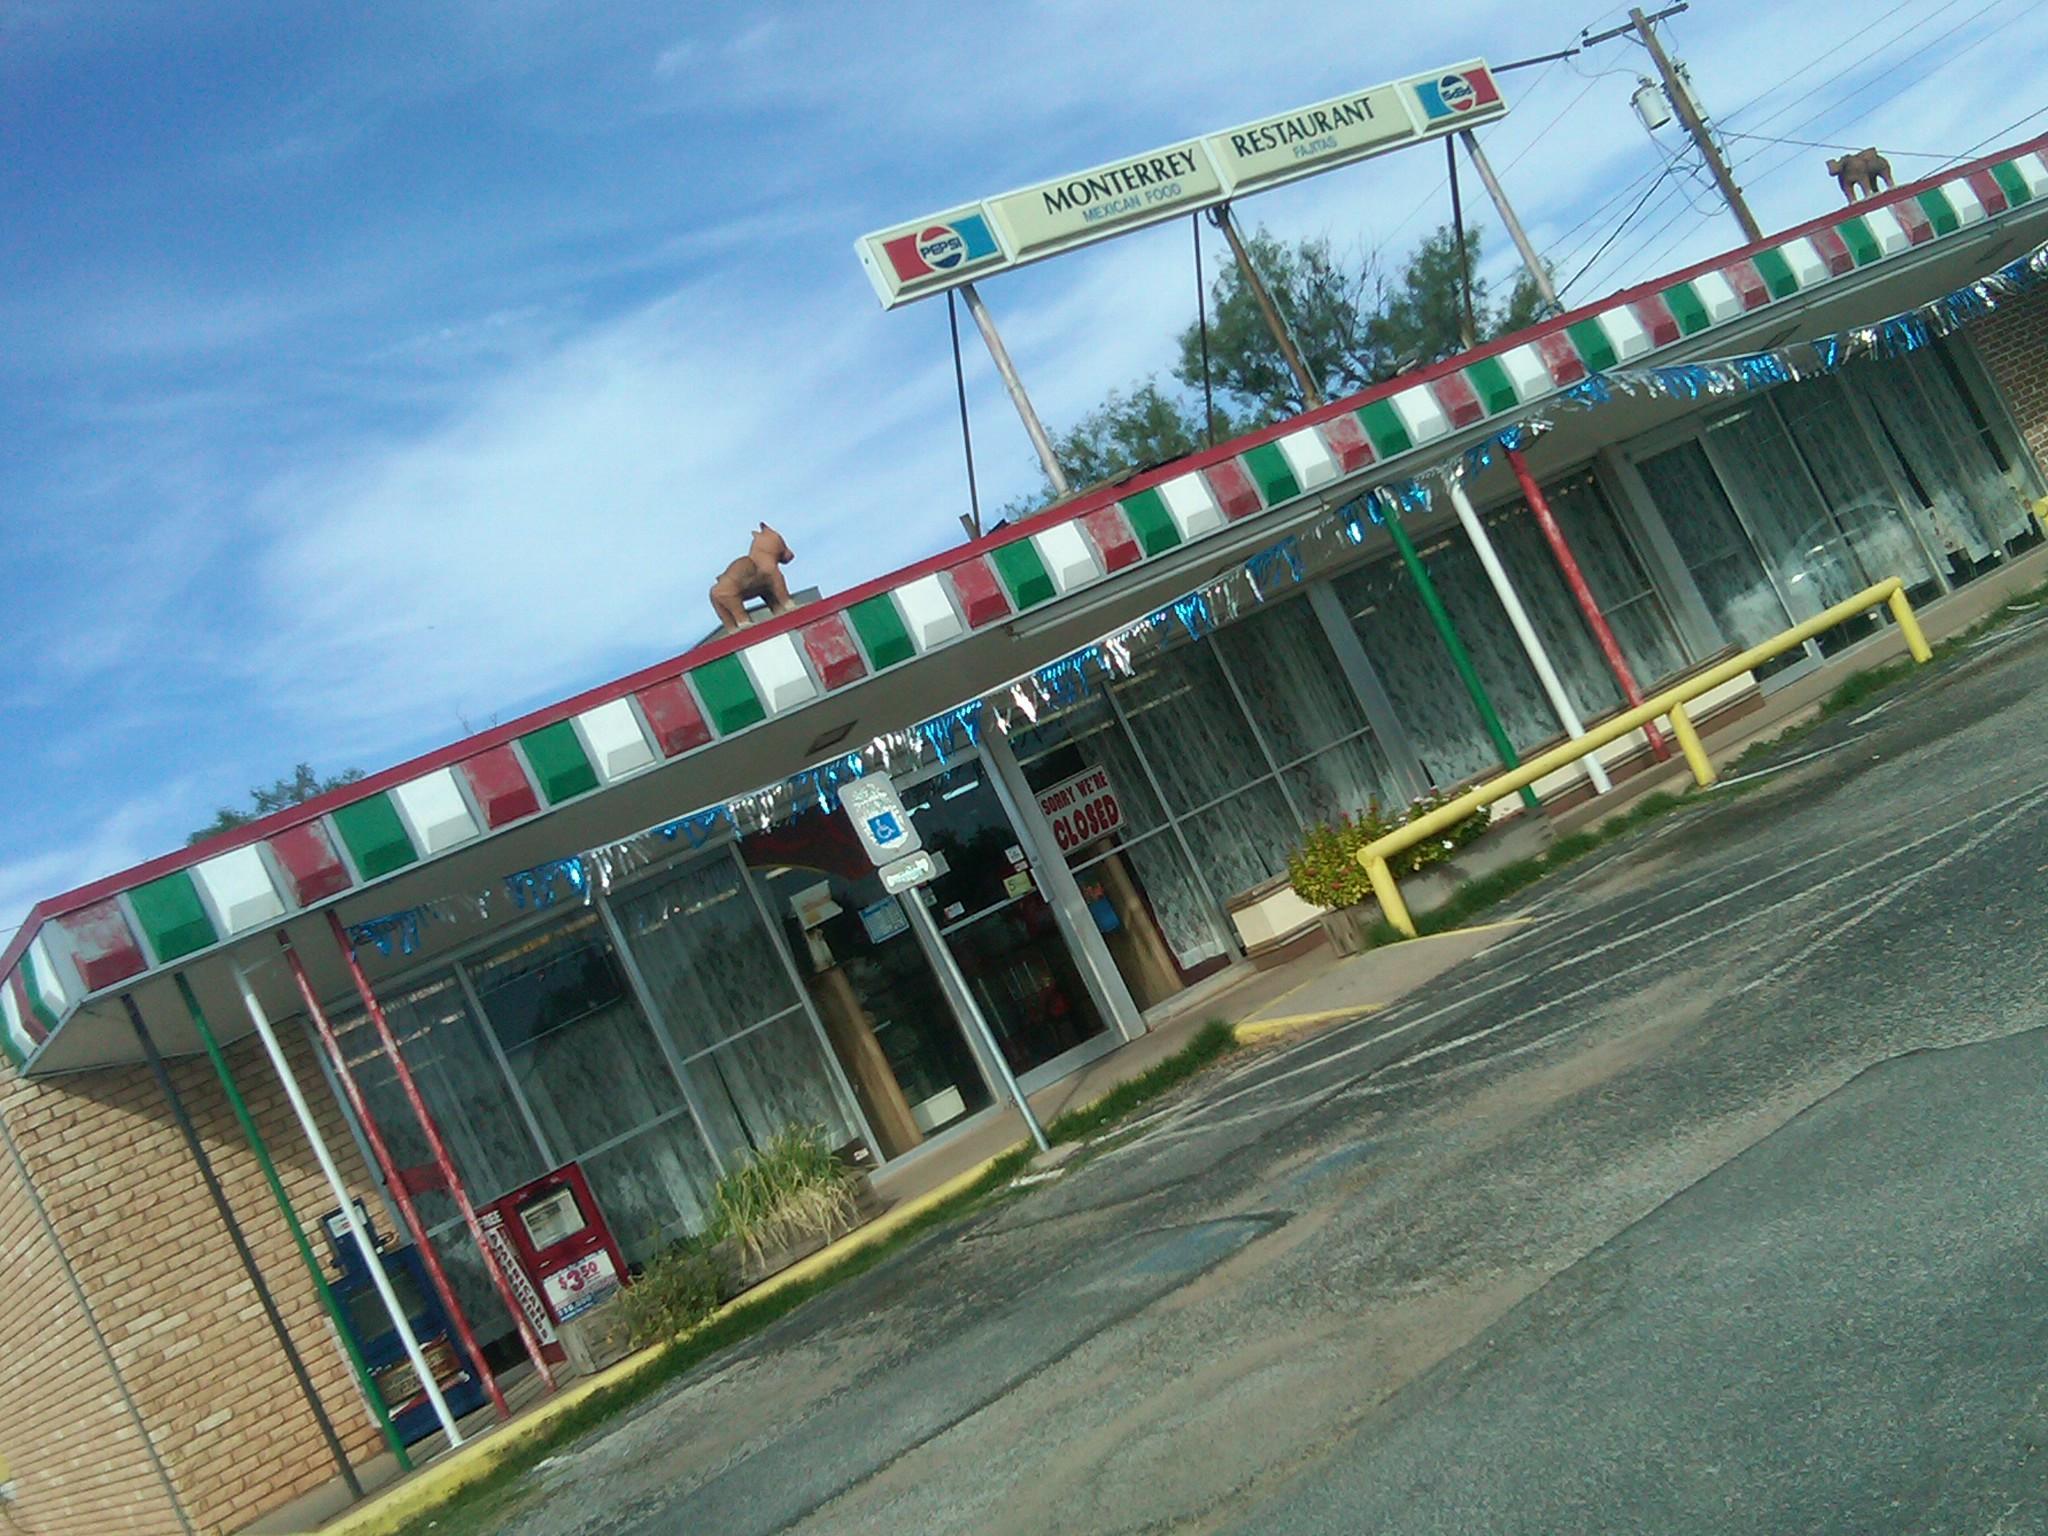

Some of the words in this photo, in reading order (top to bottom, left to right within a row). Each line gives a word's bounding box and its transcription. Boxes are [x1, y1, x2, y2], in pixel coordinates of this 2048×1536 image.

[1042, 148, 1197, 216] MONTERREY
[1231, 97, 1375, 157] RESTAURANT
[1292, 138, 1337, 158] FAJITAS
[1082, 196, 1141, 223] MEXICAN
[1145, 184, 1182, 206] FOOD
[920, 238, 962, 259] PEPSI
[1041, 786, 1076, 816] SORRY
[1075, 771, 1108, 798] WE'RE
[1053, 795, 1119, 850] CLOSED
[490, 1233, 546, 1319] AMERICAN
